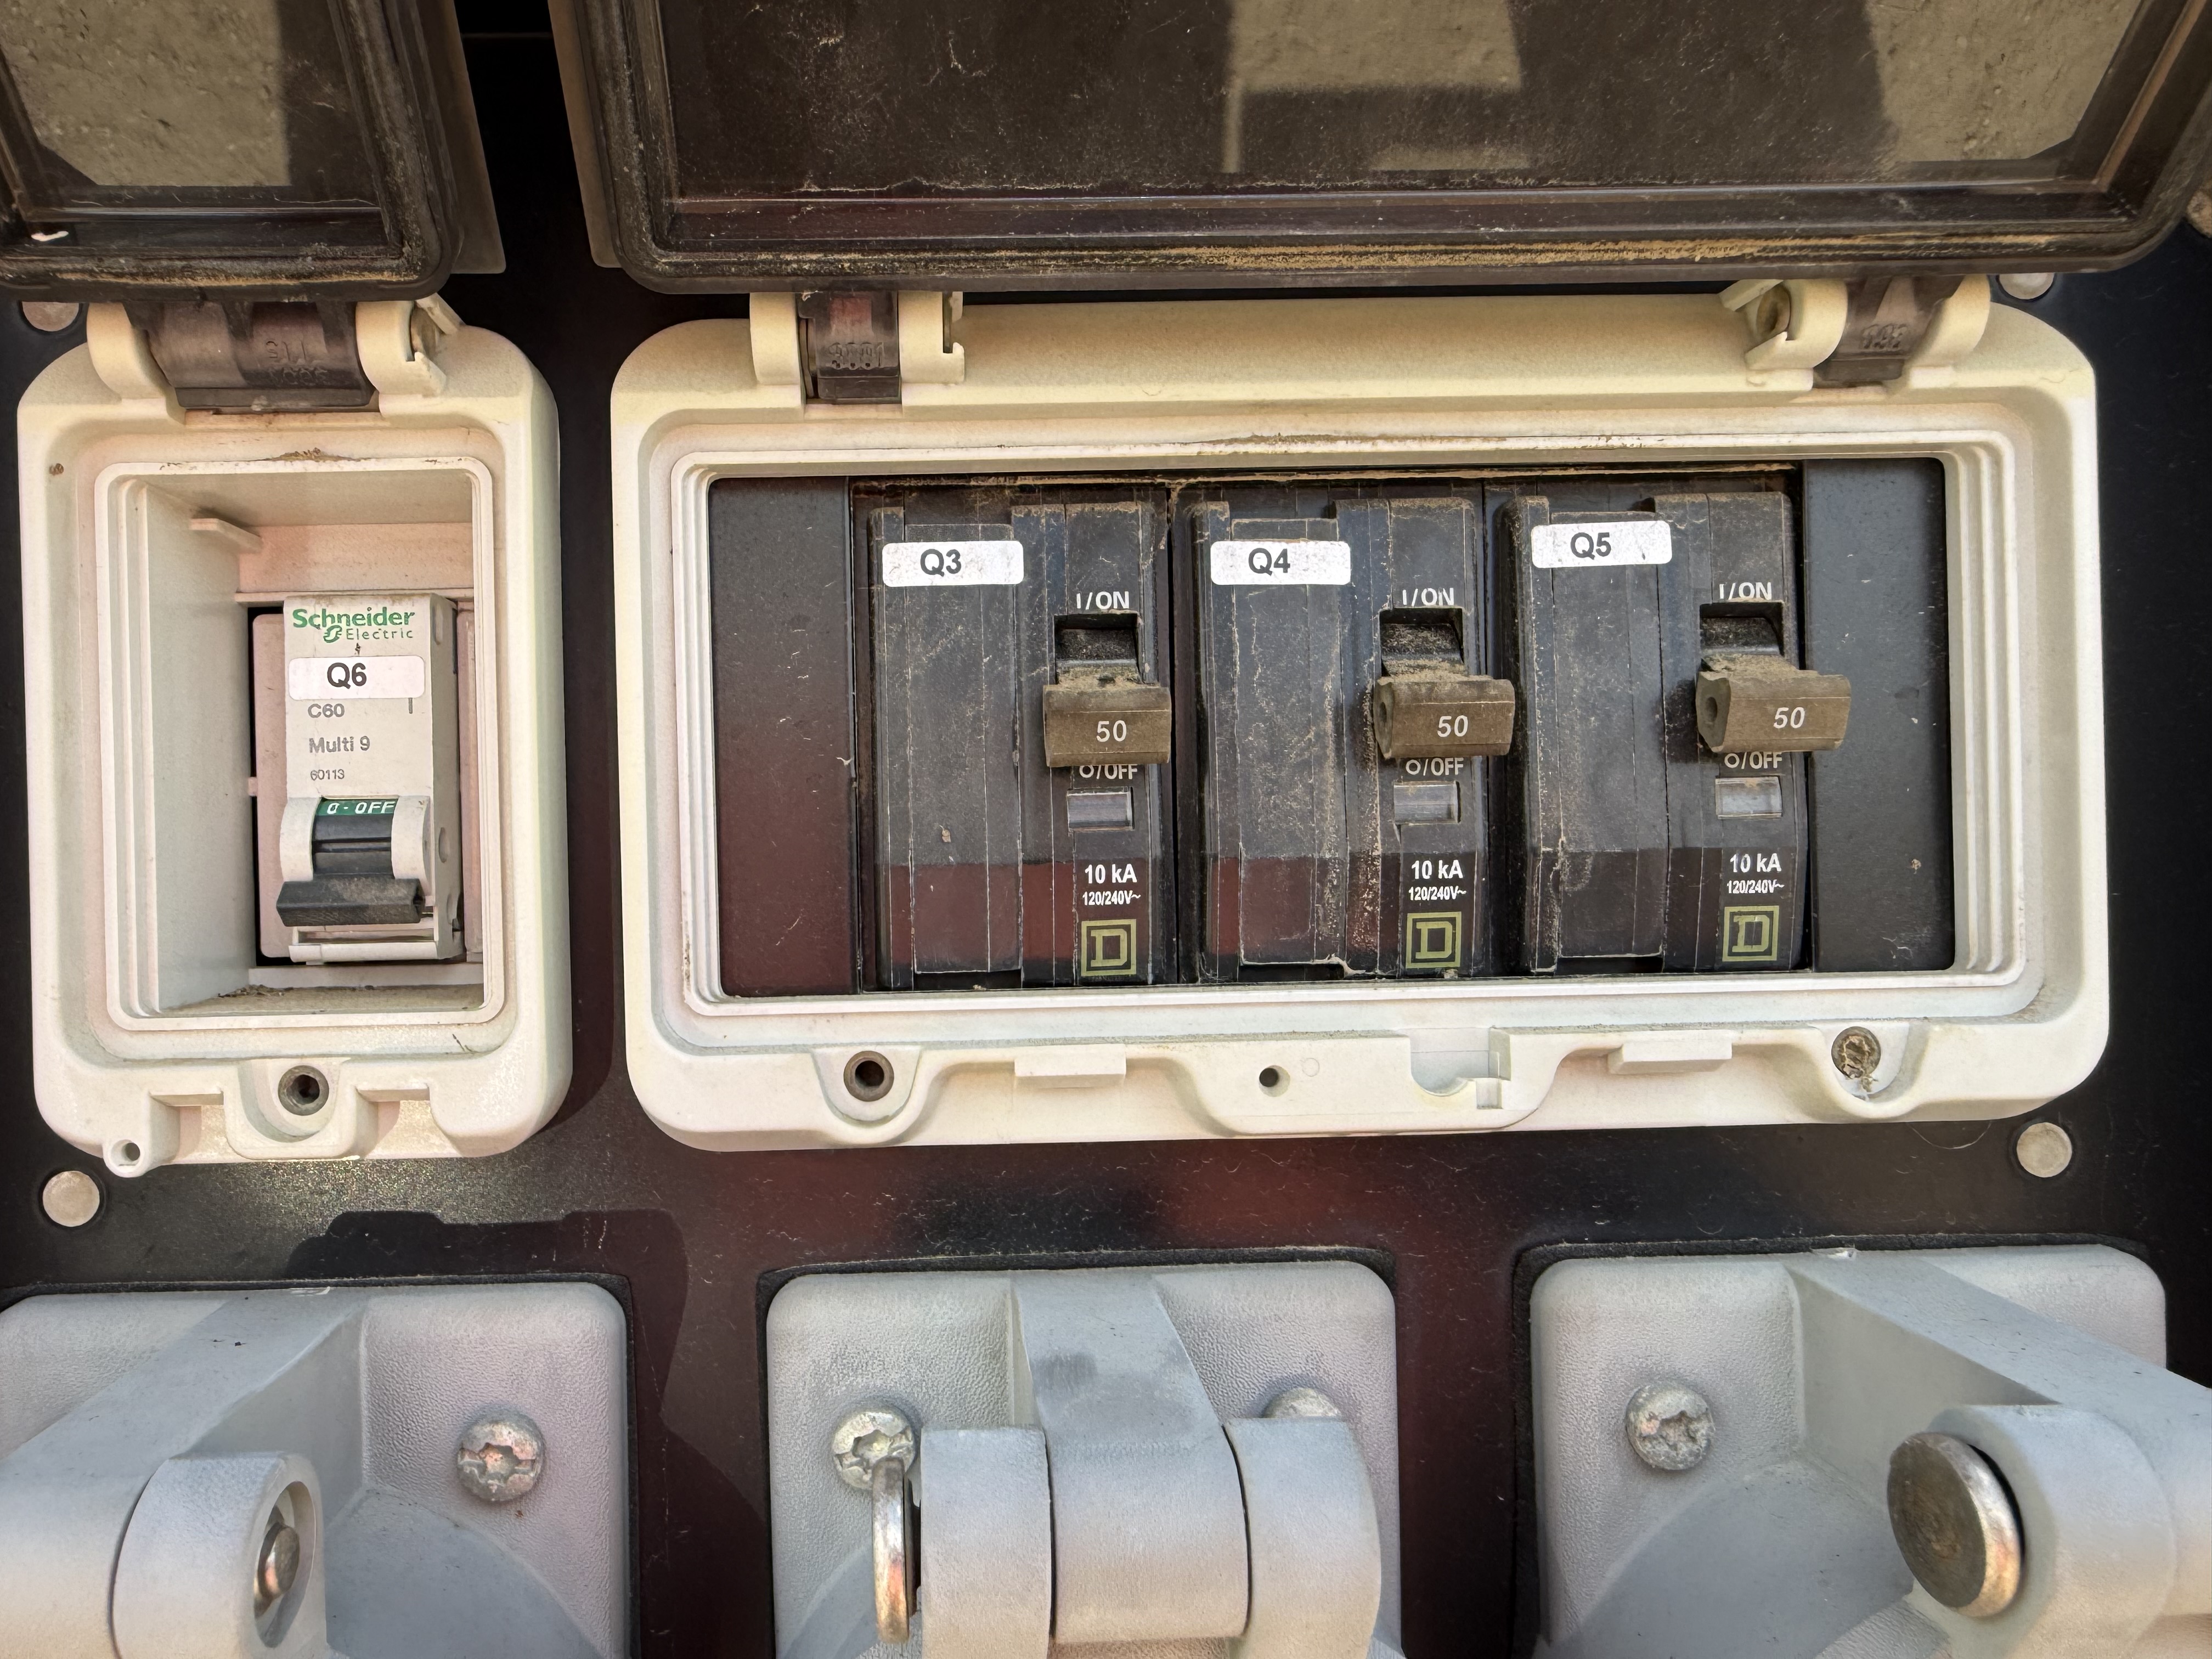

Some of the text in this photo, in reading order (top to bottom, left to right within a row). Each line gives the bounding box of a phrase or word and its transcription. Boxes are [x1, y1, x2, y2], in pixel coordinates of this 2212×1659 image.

[1570, 532, 1611, 560] Q5
[920, 549, 962, 577] Q3
[1248, 548, 1290, 575] Q4
[1076, 591, 1129, 610] I/ON
[1402, 587, 1454, 607] I/ON
[1719, 582, 1772, 601] I/ON
[292, 607, 415, 629] Schneider
[346, 628, 413, 640] Electric
[327, 662, 367, 689] Q6
[308, 703, 345, 718] C60
[1773, 707, 1805, 729] 50
[1096, 720, 1127, 742] 50
[1437, 715, 1468, 737] 50
[309, 736, 370, 753] Multi 9
[355, 801, 397, 814] OFF
[1412, 859, 1463, 879] 10 kA
[1730, 853, 1782, 873] 10 kA
[1085, 864, 1137, 884] 10 kA
